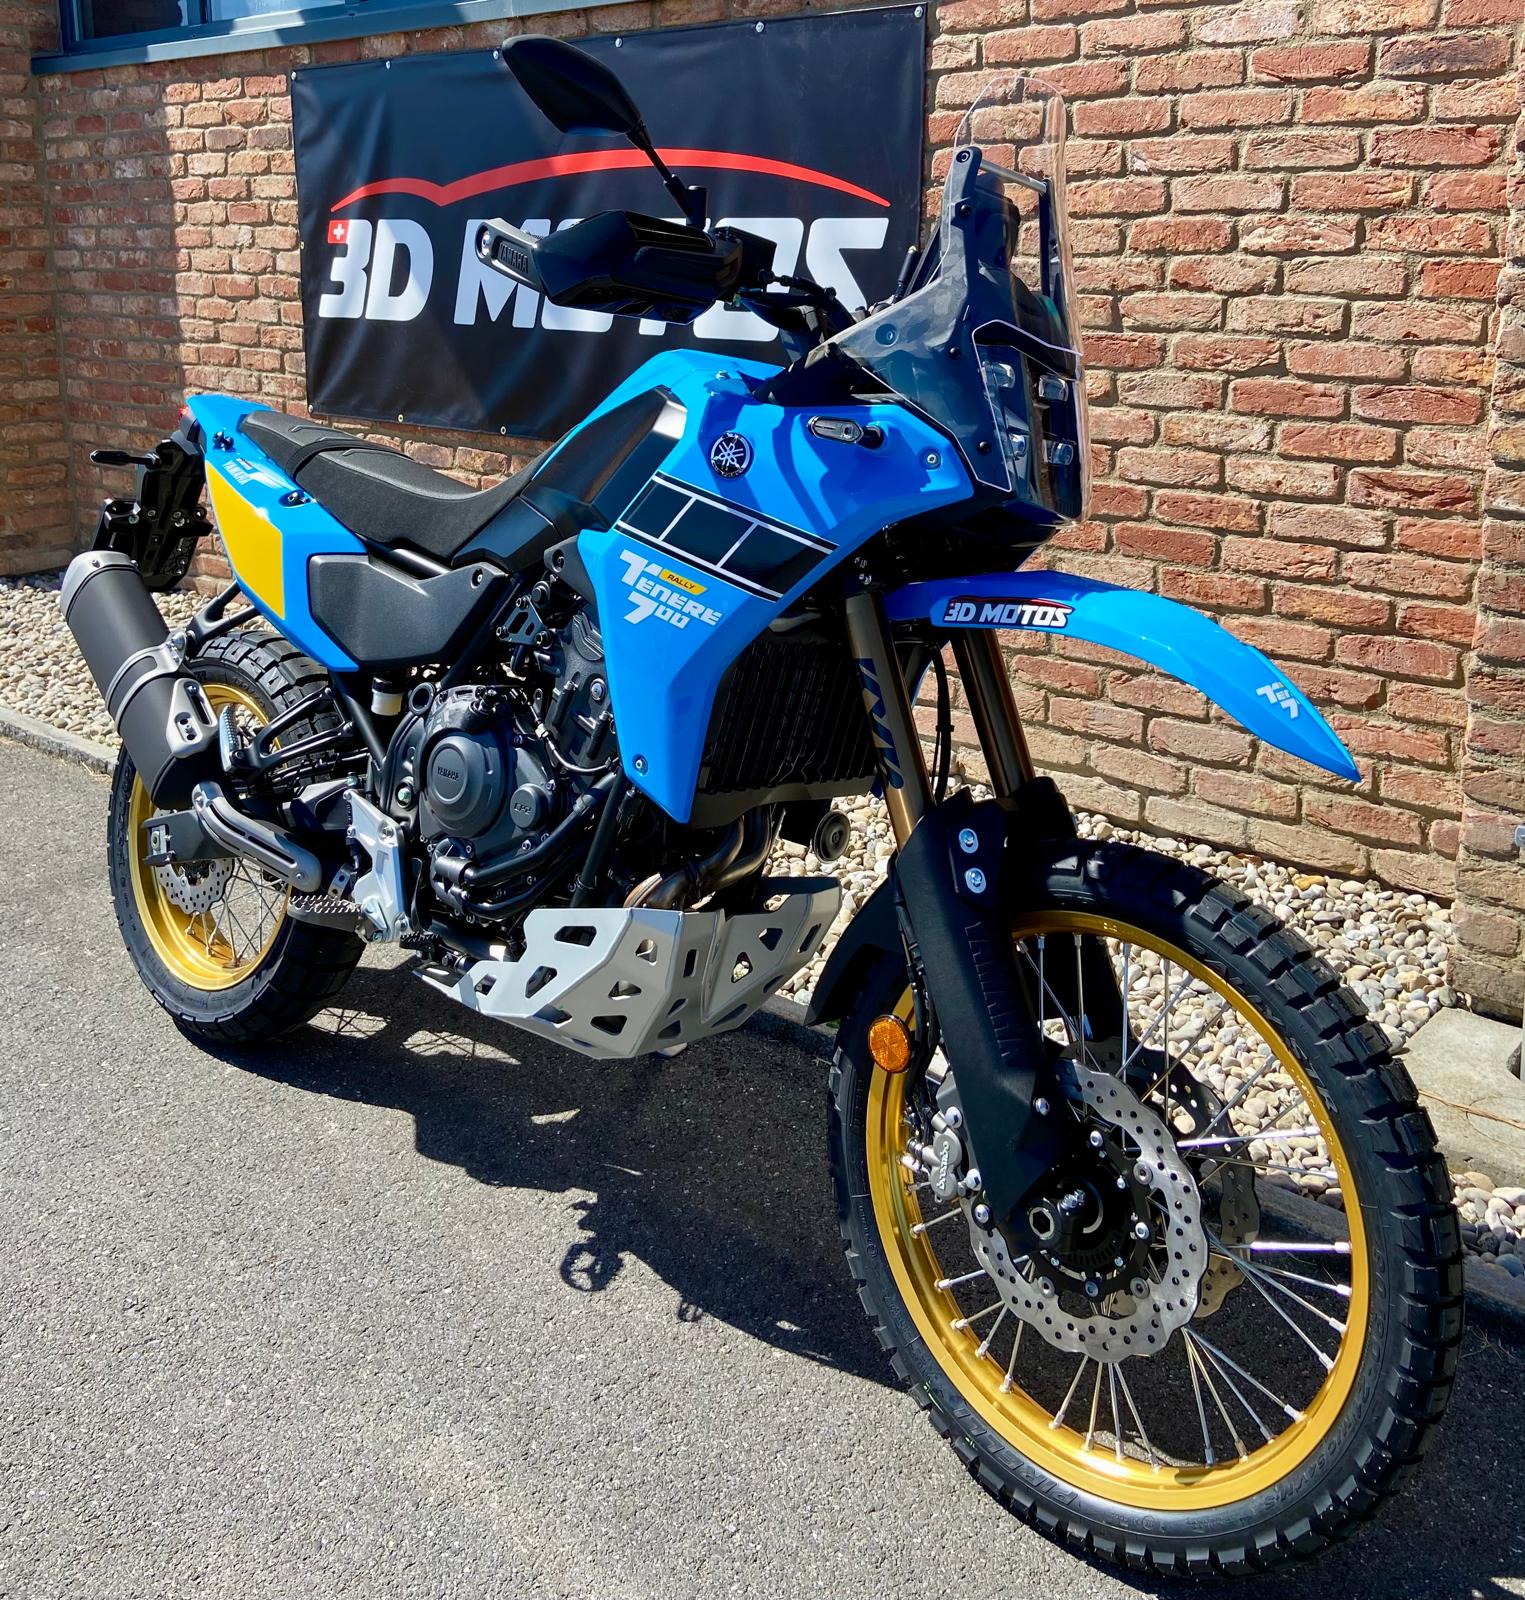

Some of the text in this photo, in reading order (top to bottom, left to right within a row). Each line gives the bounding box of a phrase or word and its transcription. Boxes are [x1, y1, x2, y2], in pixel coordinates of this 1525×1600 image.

[318, 218, 434, 322] 3D
[500, 242, 529, 275] YAMAHA
[667, 573, 695, 591] RALLY
[623, 590, 691, 630] 700
[943, 602, 1073, 628] 3D MOTOS
[437, 765, 460, 781] YAMAHA
[936, 1140, 951, 1191] brembo
[952, 1407, 1080, 1507] PIRELLI
